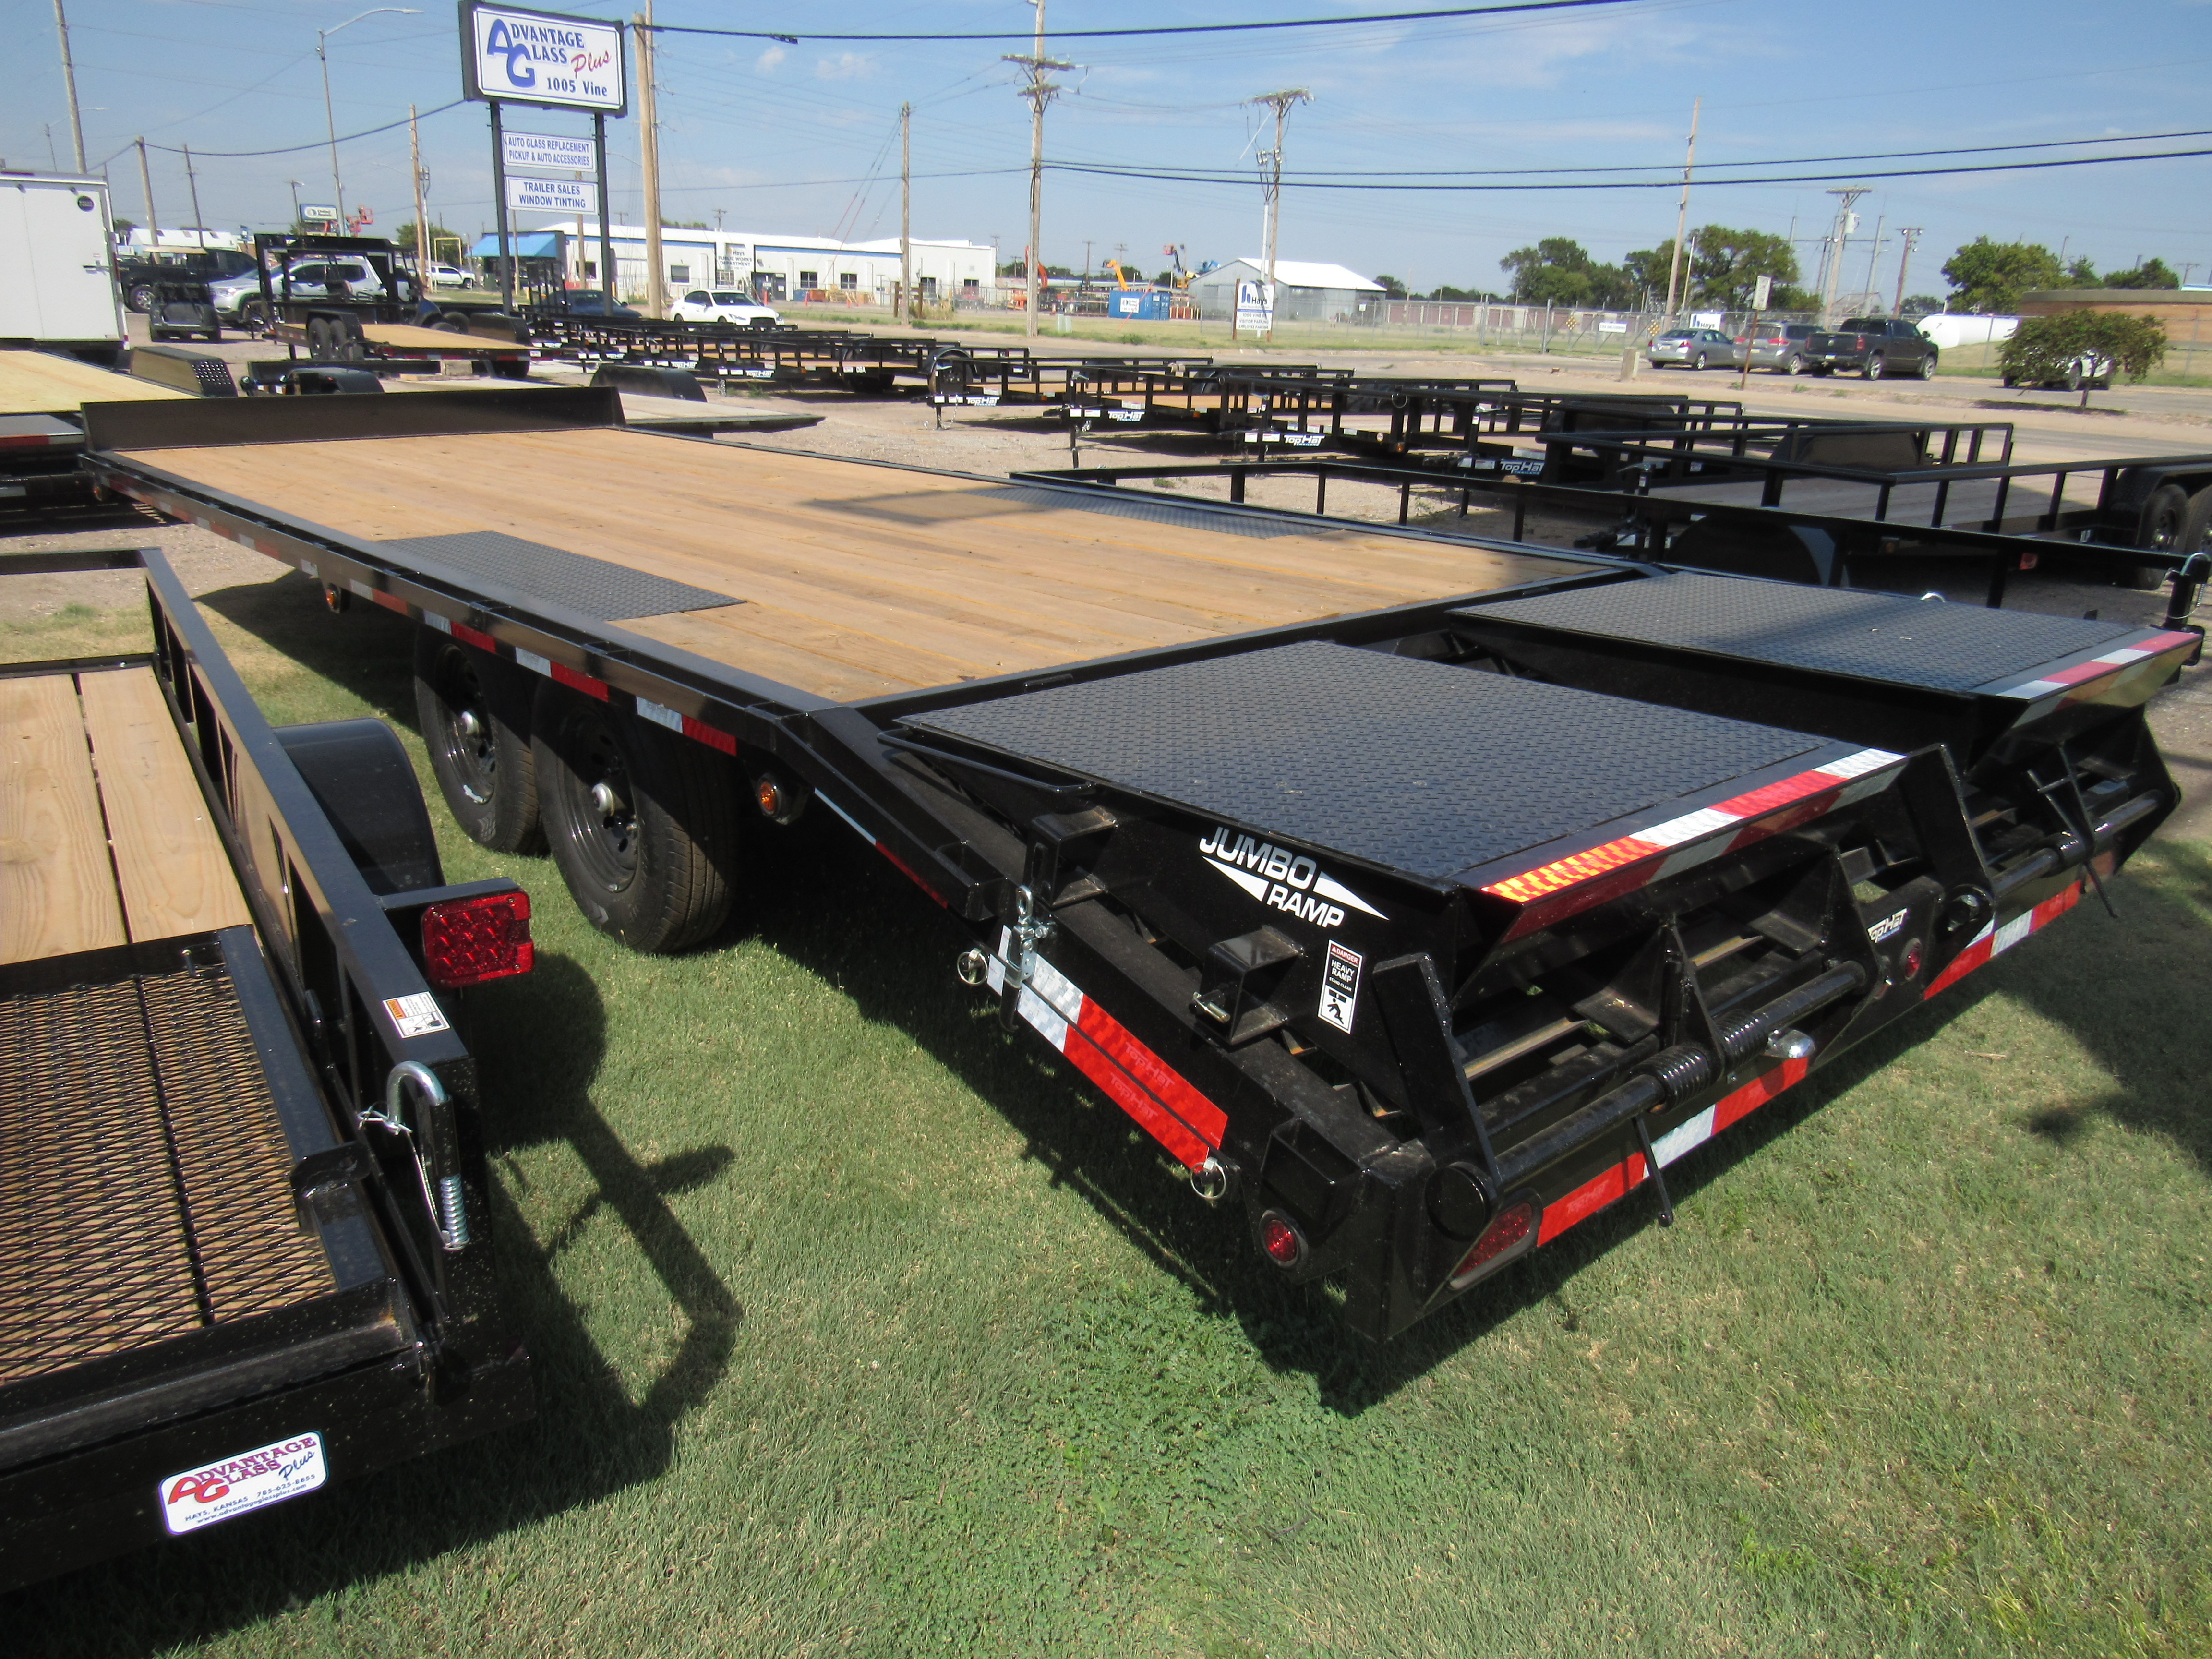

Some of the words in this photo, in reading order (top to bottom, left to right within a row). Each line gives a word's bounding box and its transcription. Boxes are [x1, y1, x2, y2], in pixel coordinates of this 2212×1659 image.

[571, 50, 612, 78] Plus
[547, 78, 576, 93] 1005
[582, 81, 608, 96] Vine
[509, 137, 525, 147] AUTO
[527, 139, 546, 149] GLASS
[547, 141, 590, 153] REPLACEMENT
[509, 150, 530, 161] PICKUP
[532, 152, 535, 161] &
[537, 153, 552, 163] AUTO
[553, 154, 590, 166] ACCESSORIES
[524, 182, 555, 192] TRAILER
[557, 184, 580, 195] SALES
[519, 194, 552, 206] WINDOW
[554, 197, 586, 208] TINTING
[1251, 296, 1267, 305] Hays
[1199, 826, 1317, 890] JUMBO
[1266, 883, 1345, 928] RAMP
[1336, 948, 1358, 964] DANGER
[1331, 959, 1355, 976] HEAVY
[1331, 967, 1352, 983] RAMP
[1329, 977, 1340, 986] STAND
[1340, 982, 1352, 992] CLEAR
[278, 1450, 315, 1481] Plus
[185, 1510, 211, 1522] HAYS,
[213, 1496, 249, 1515] KANSAS
[257, 1474, 316, 1498] 785-625-8855
